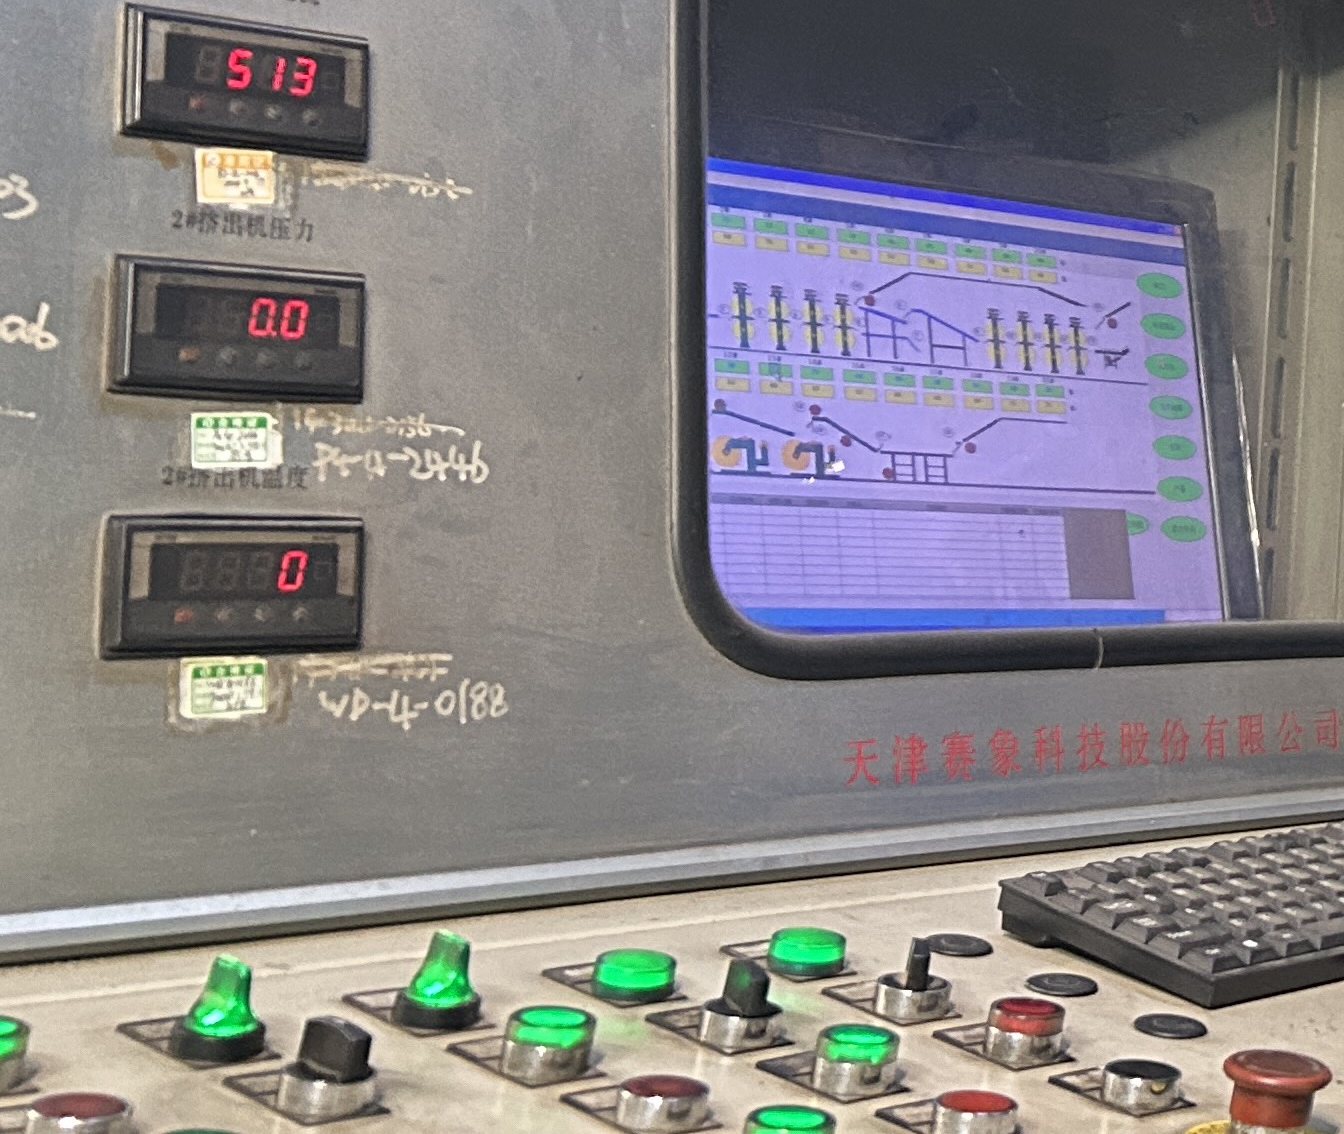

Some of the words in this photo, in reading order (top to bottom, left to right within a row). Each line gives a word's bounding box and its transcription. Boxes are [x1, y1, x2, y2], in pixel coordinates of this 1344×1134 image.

[248, 297, 310, 340] 0.0
[277, 550, 308, 593] 0
[843, 708, 1341, 787] 天津赛象科技股份有限公司
